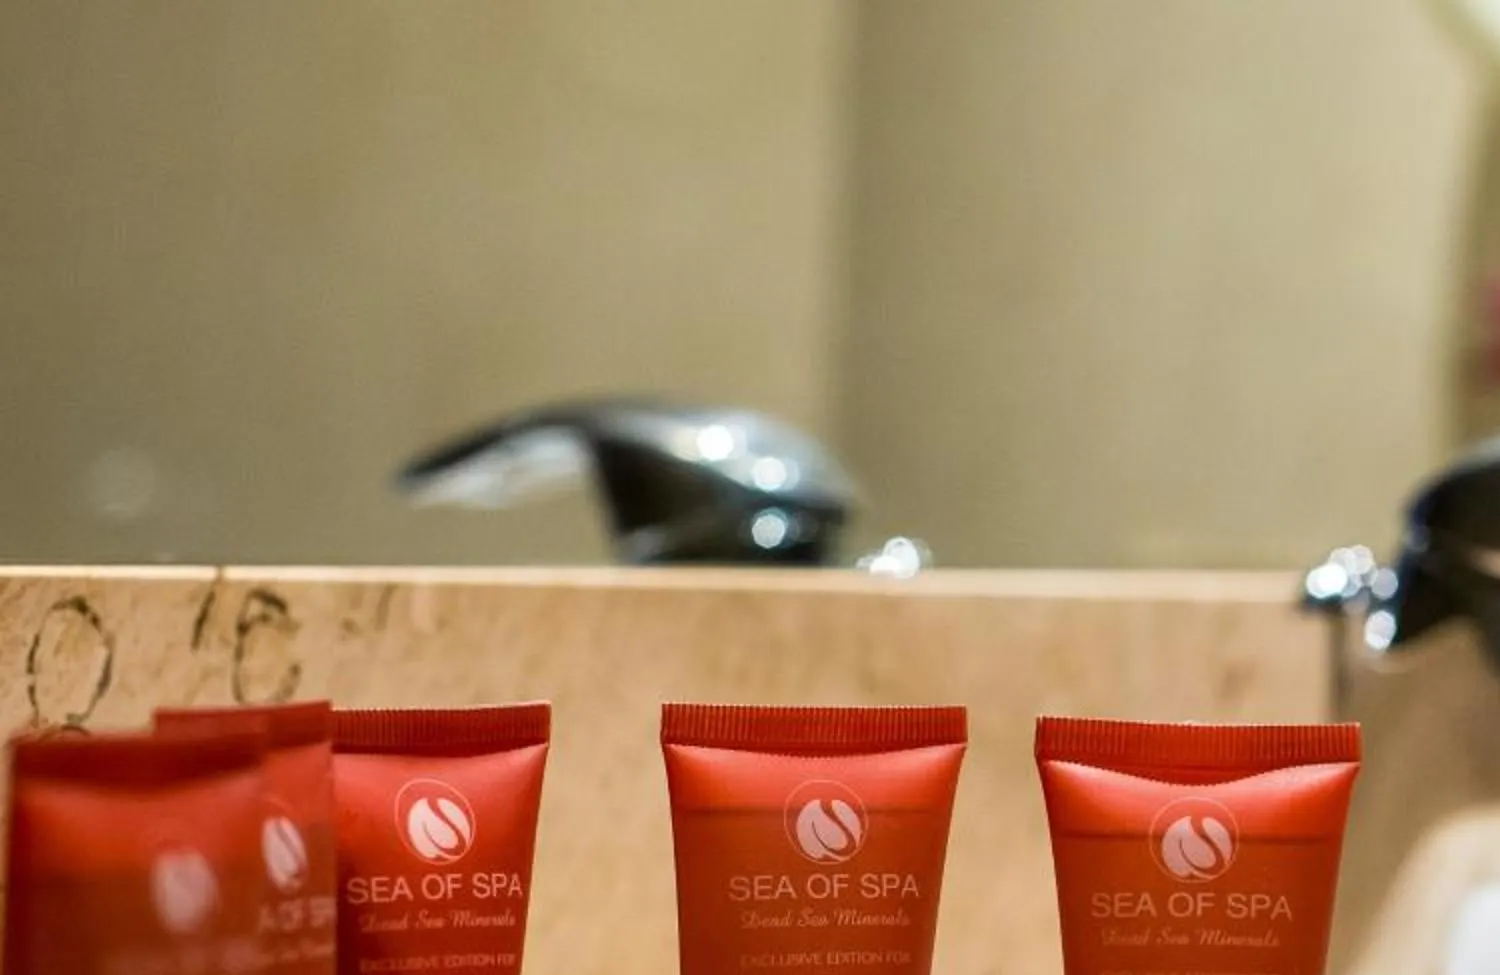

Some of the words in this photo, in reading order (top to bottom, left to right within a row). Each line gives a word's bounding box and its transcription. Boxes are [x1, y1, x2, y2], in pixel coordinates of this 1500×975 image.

[347, 876, 414, 905] SEA
[421, 873, 463, 901] OF
[471, 872, 523, 899] SPA
[728, 874, 797, 902] SEA
[806, 873, 849, 900] OF
[859, 872, 920, 899] SPA
[414, 908, 446, 930] Sea
[797, 906, 831, 928] Sea
[833, 906, 912, 928] Minerals
[1091, 891, 1157, 918] SEA
[1167, 891, 1216, 917] OF
[1225, 892, 1294, 921] SPA
[1155, 926, 1190, 946] Sea
[1194, 927, 1282, 947] Minerals
